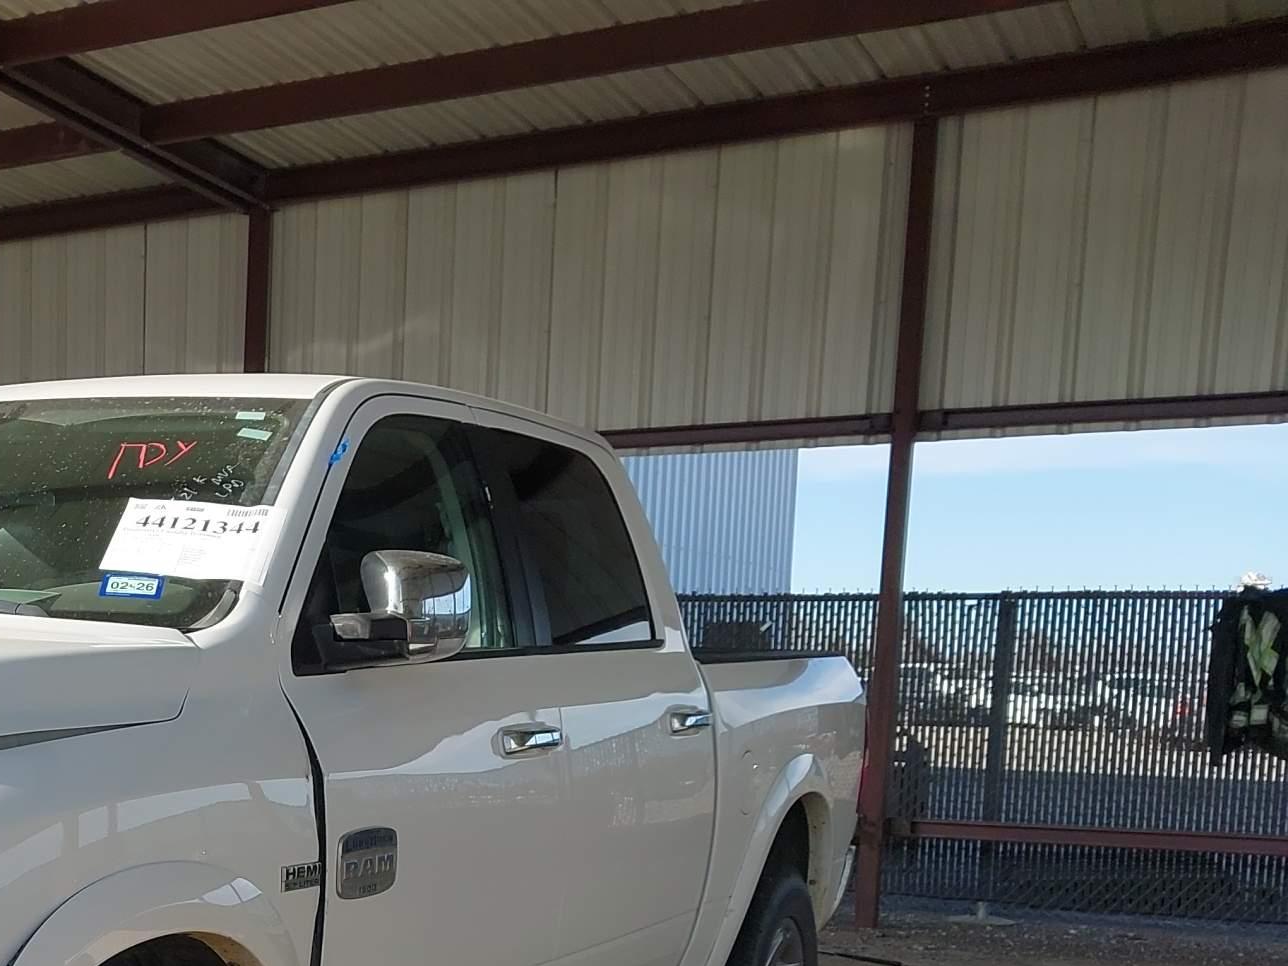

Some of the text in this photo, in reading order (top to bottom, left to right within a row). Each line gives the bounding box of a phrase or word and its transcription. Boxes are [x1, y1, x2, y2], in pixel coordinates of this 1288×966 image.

[135, 514, 261, 535] 44121344
[286, 863, 321, 881] HEMI
[343, 852, 393, 880] RAM
